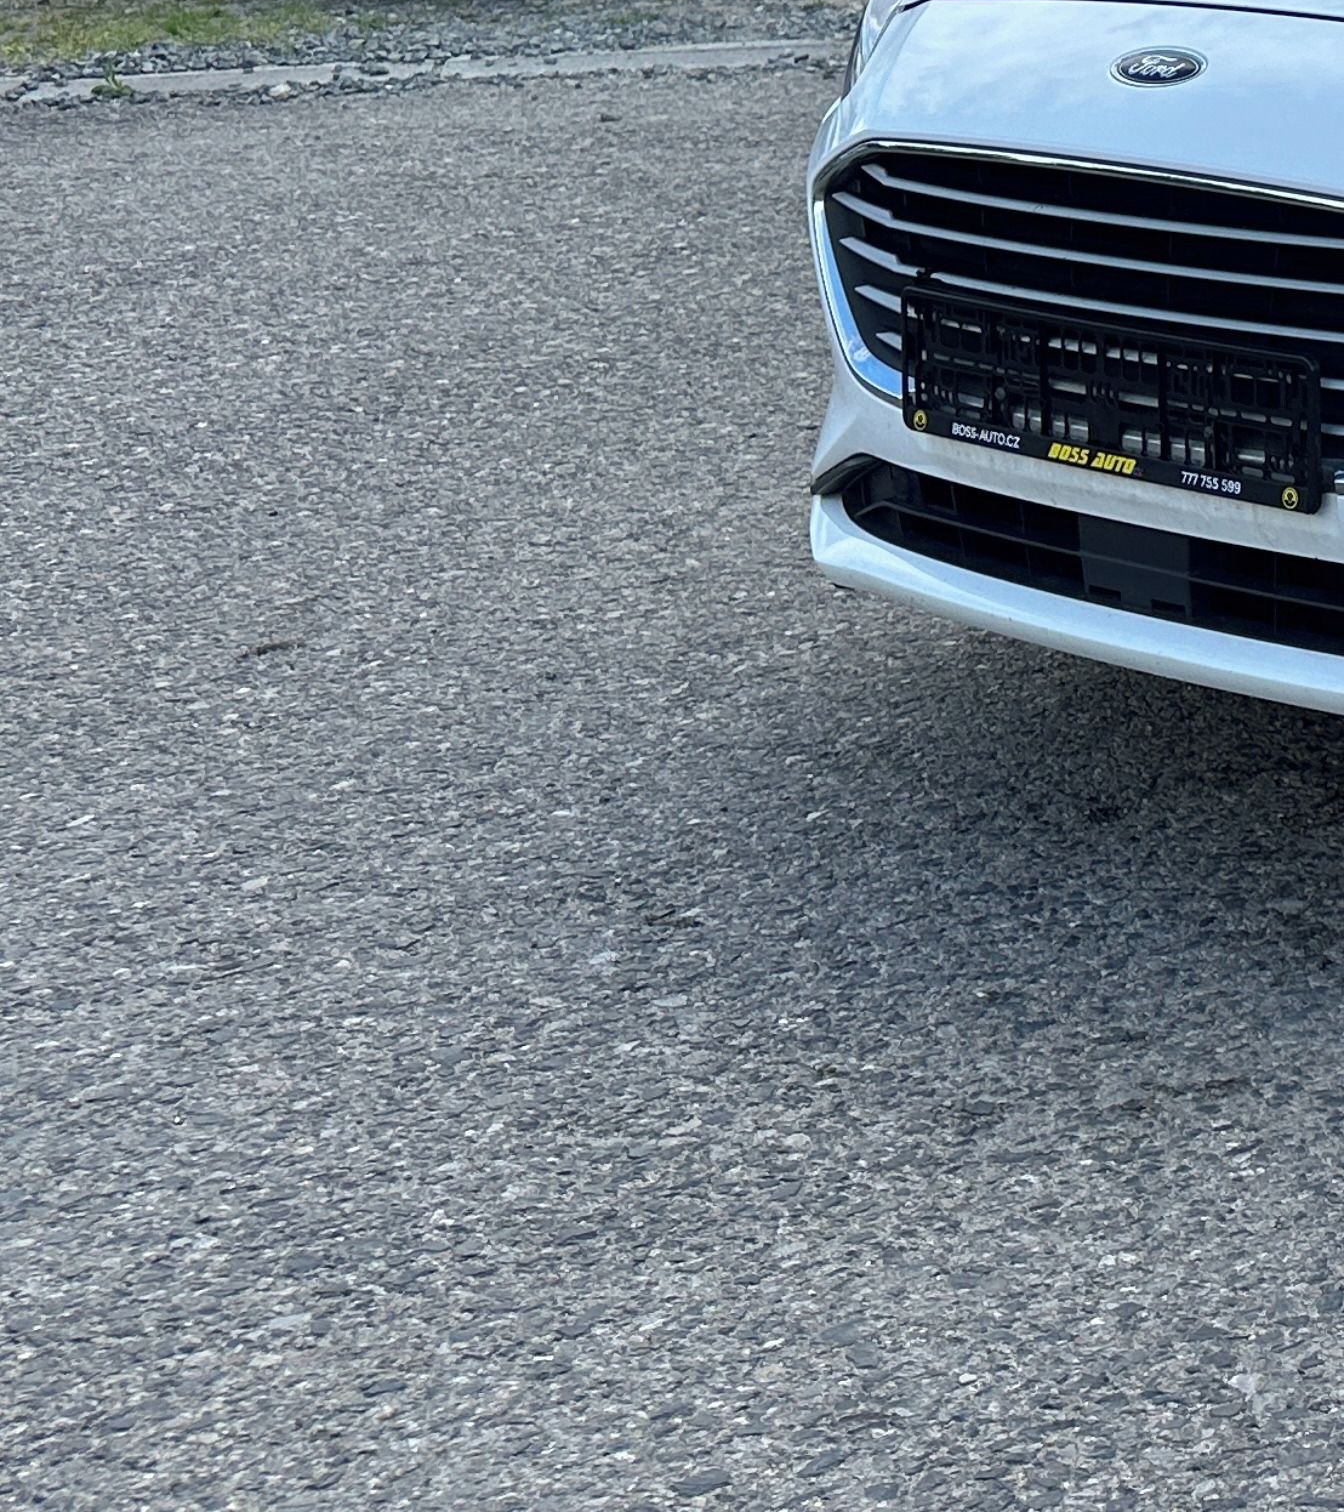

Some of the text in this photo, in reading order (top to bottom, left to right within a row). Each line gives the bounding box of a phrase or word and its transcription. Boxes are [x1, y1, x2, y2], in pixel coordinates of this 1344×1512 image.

[1128, 55, 1185, 78] Ford
[952, 422, 1242, 494] BOSS-AUTO.CZ BOSS AUTO 777 755 599
